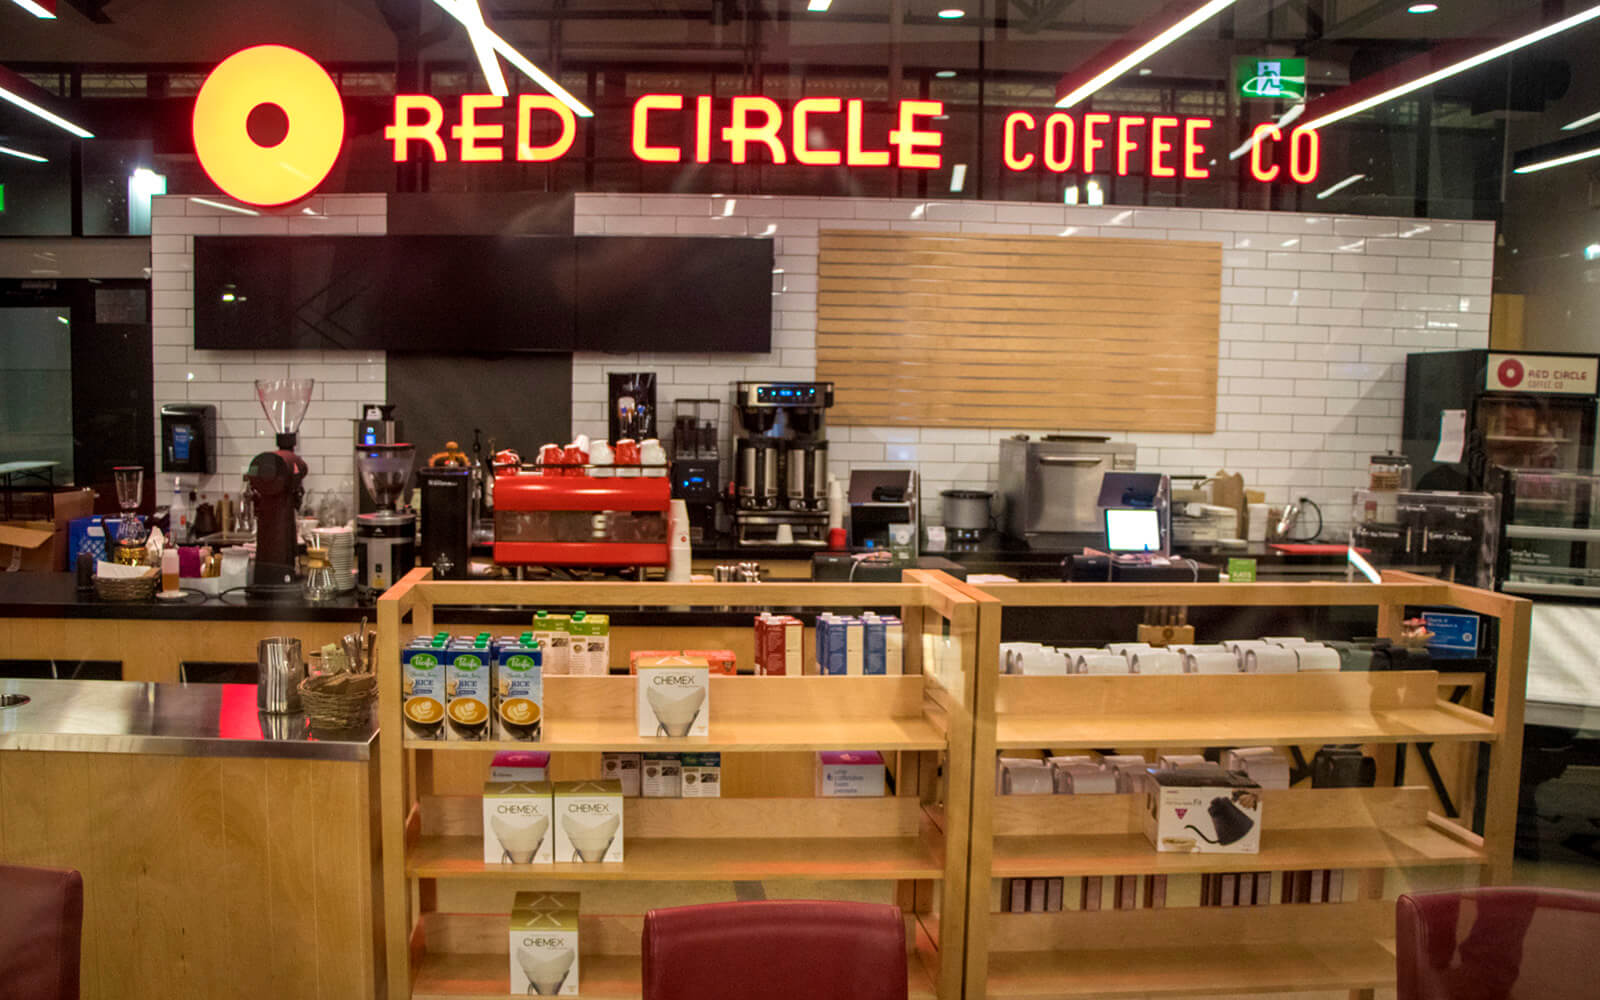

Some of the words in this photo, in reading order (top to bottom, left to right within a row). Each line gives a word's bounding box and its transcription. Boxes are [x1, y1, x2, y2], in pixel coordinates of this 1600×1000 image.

[384, 93, 577, 163] RED
[631, 93, 944, 169] CIRCLE
[1003, 111, 1213, 179] COFFEE
[1251, 122, 1320, 184] CO
[1528, 369, 1550, 379] RED
[1553, 370, 1588, 381] CIRCLE
[653, 675, 695, 685] CHEMEX
[497, 804, 539, 814] CHEMEX
[568, 803, 610, 813] CHEMEX
[523, 937, 565, 947] CHEMEX
